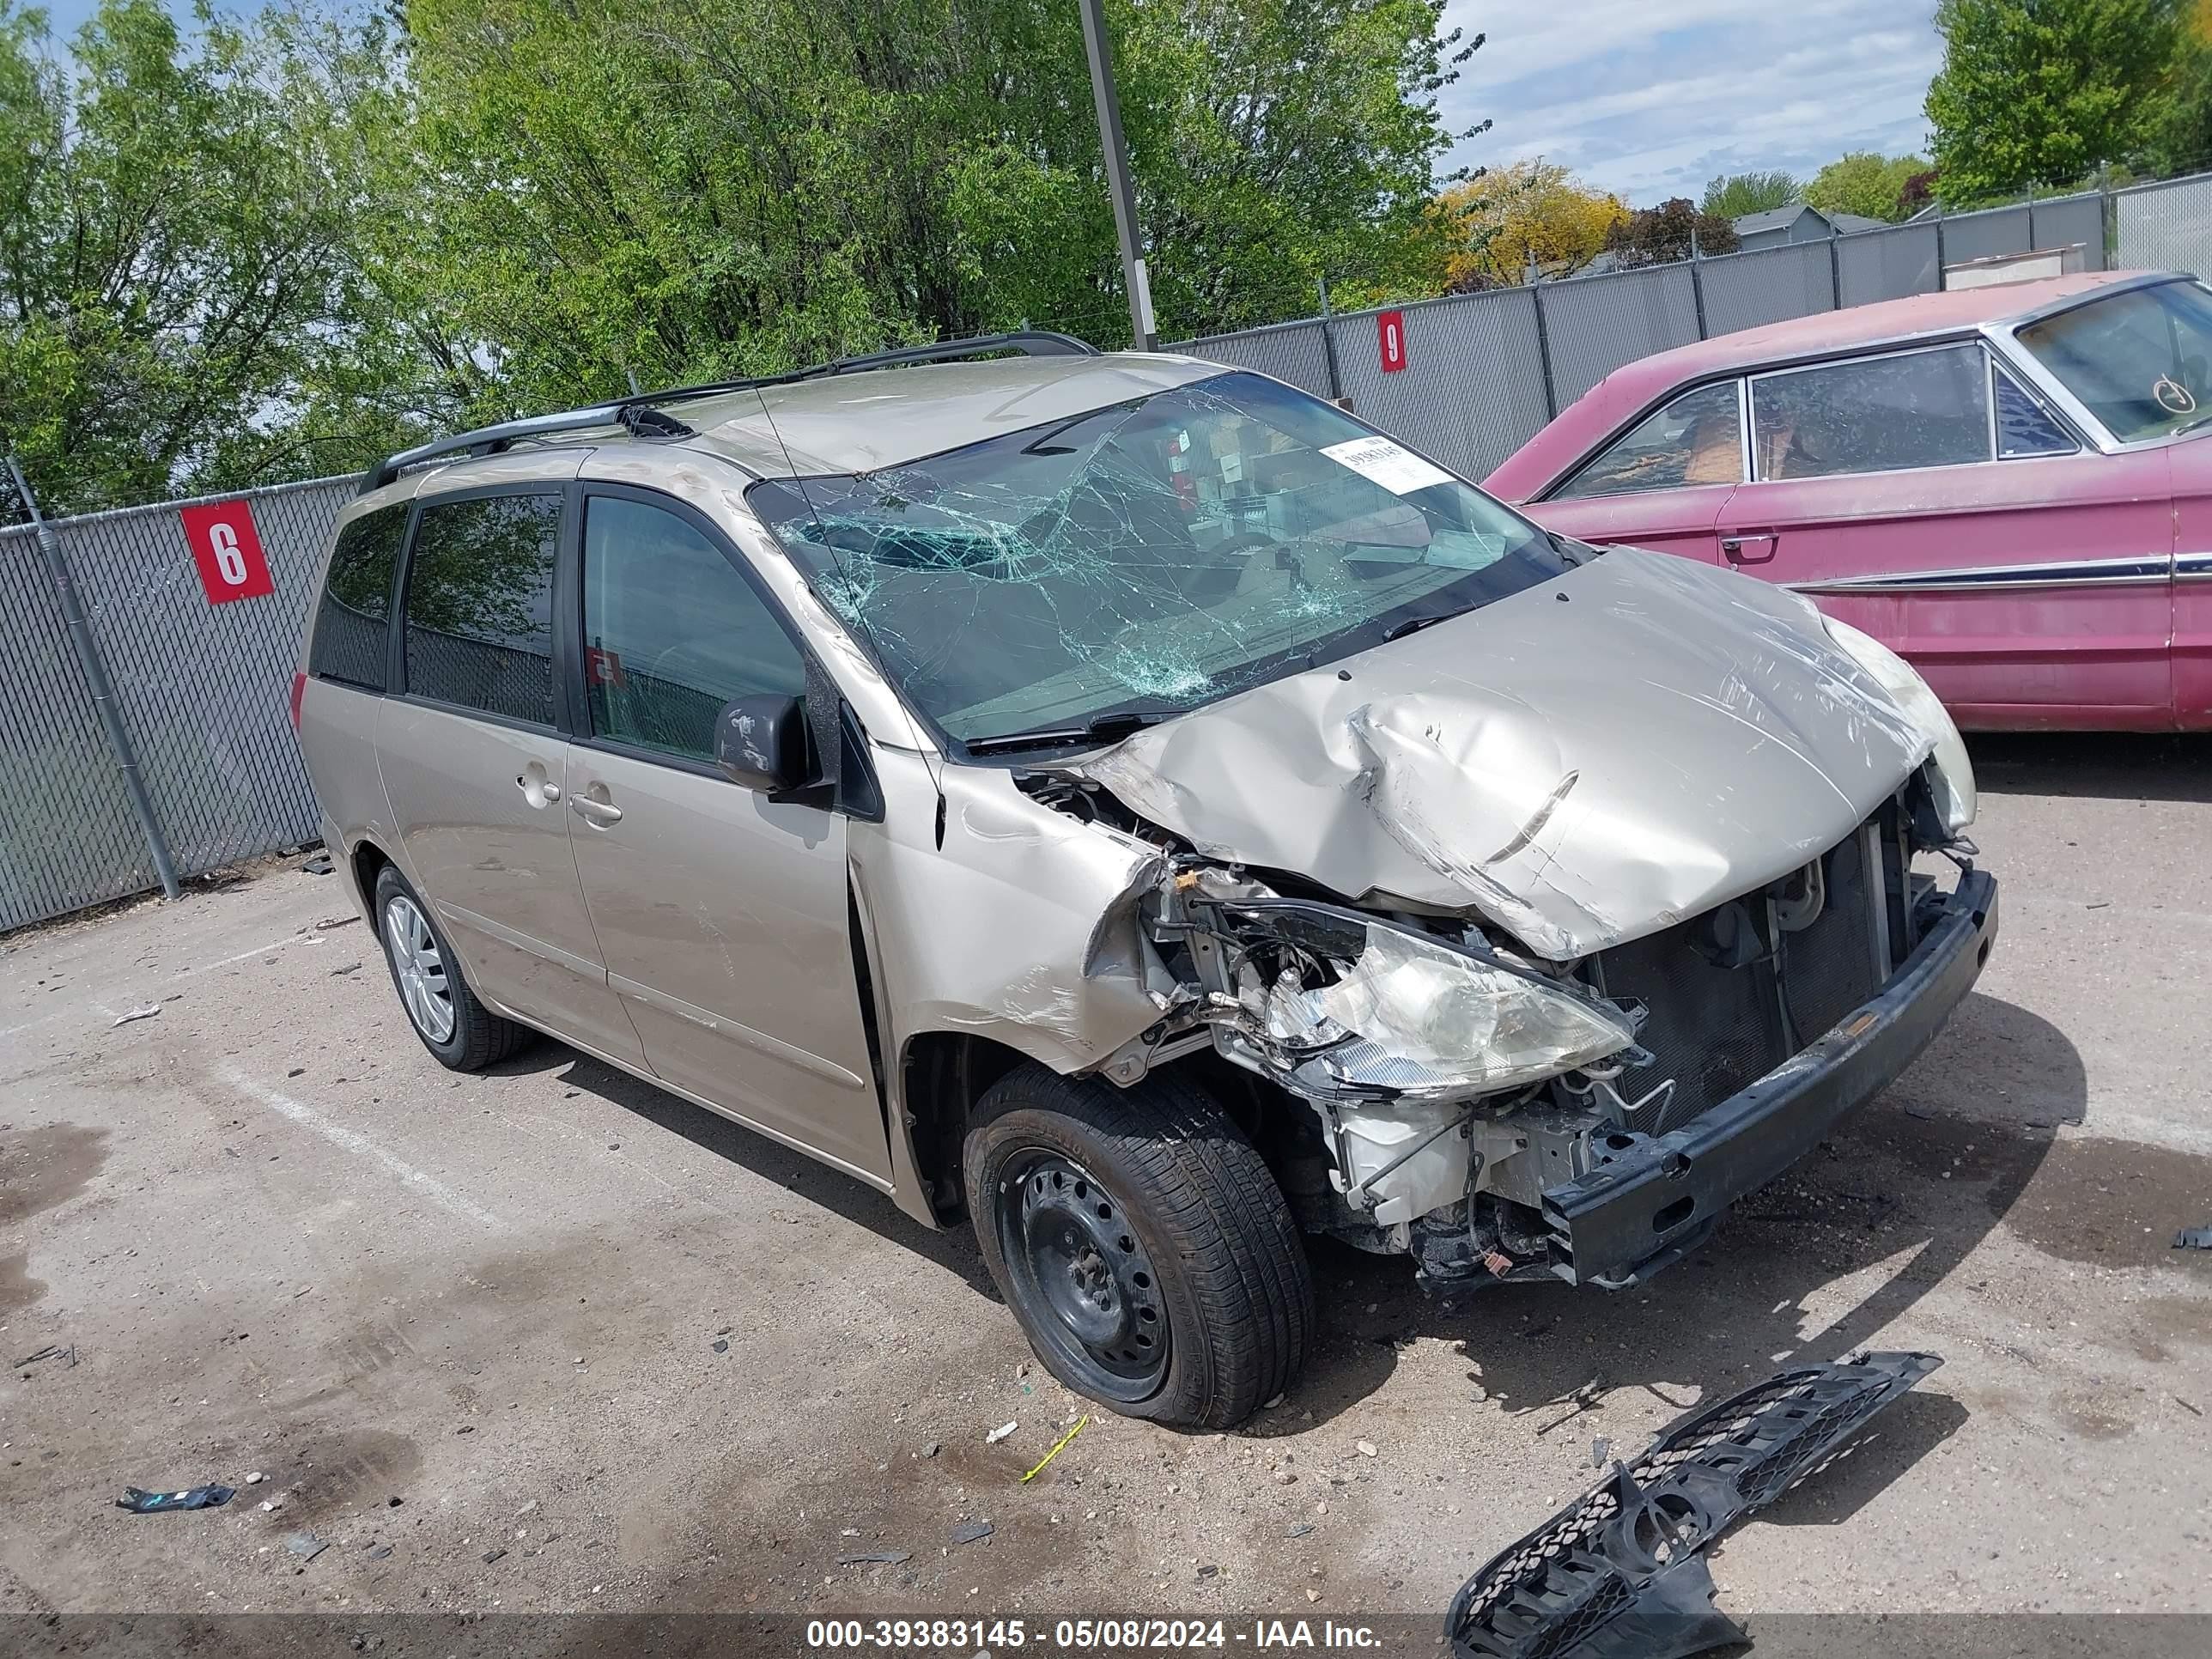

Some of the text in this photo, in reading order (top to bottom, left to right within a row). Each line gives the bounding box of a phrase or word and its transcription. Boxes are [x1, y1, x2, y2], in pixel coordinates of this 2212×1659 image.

[1387, 324, 1399, 362] 9
[1344, 446, 1402, 467] 39383145
[209, 522, 248, 586] 6
